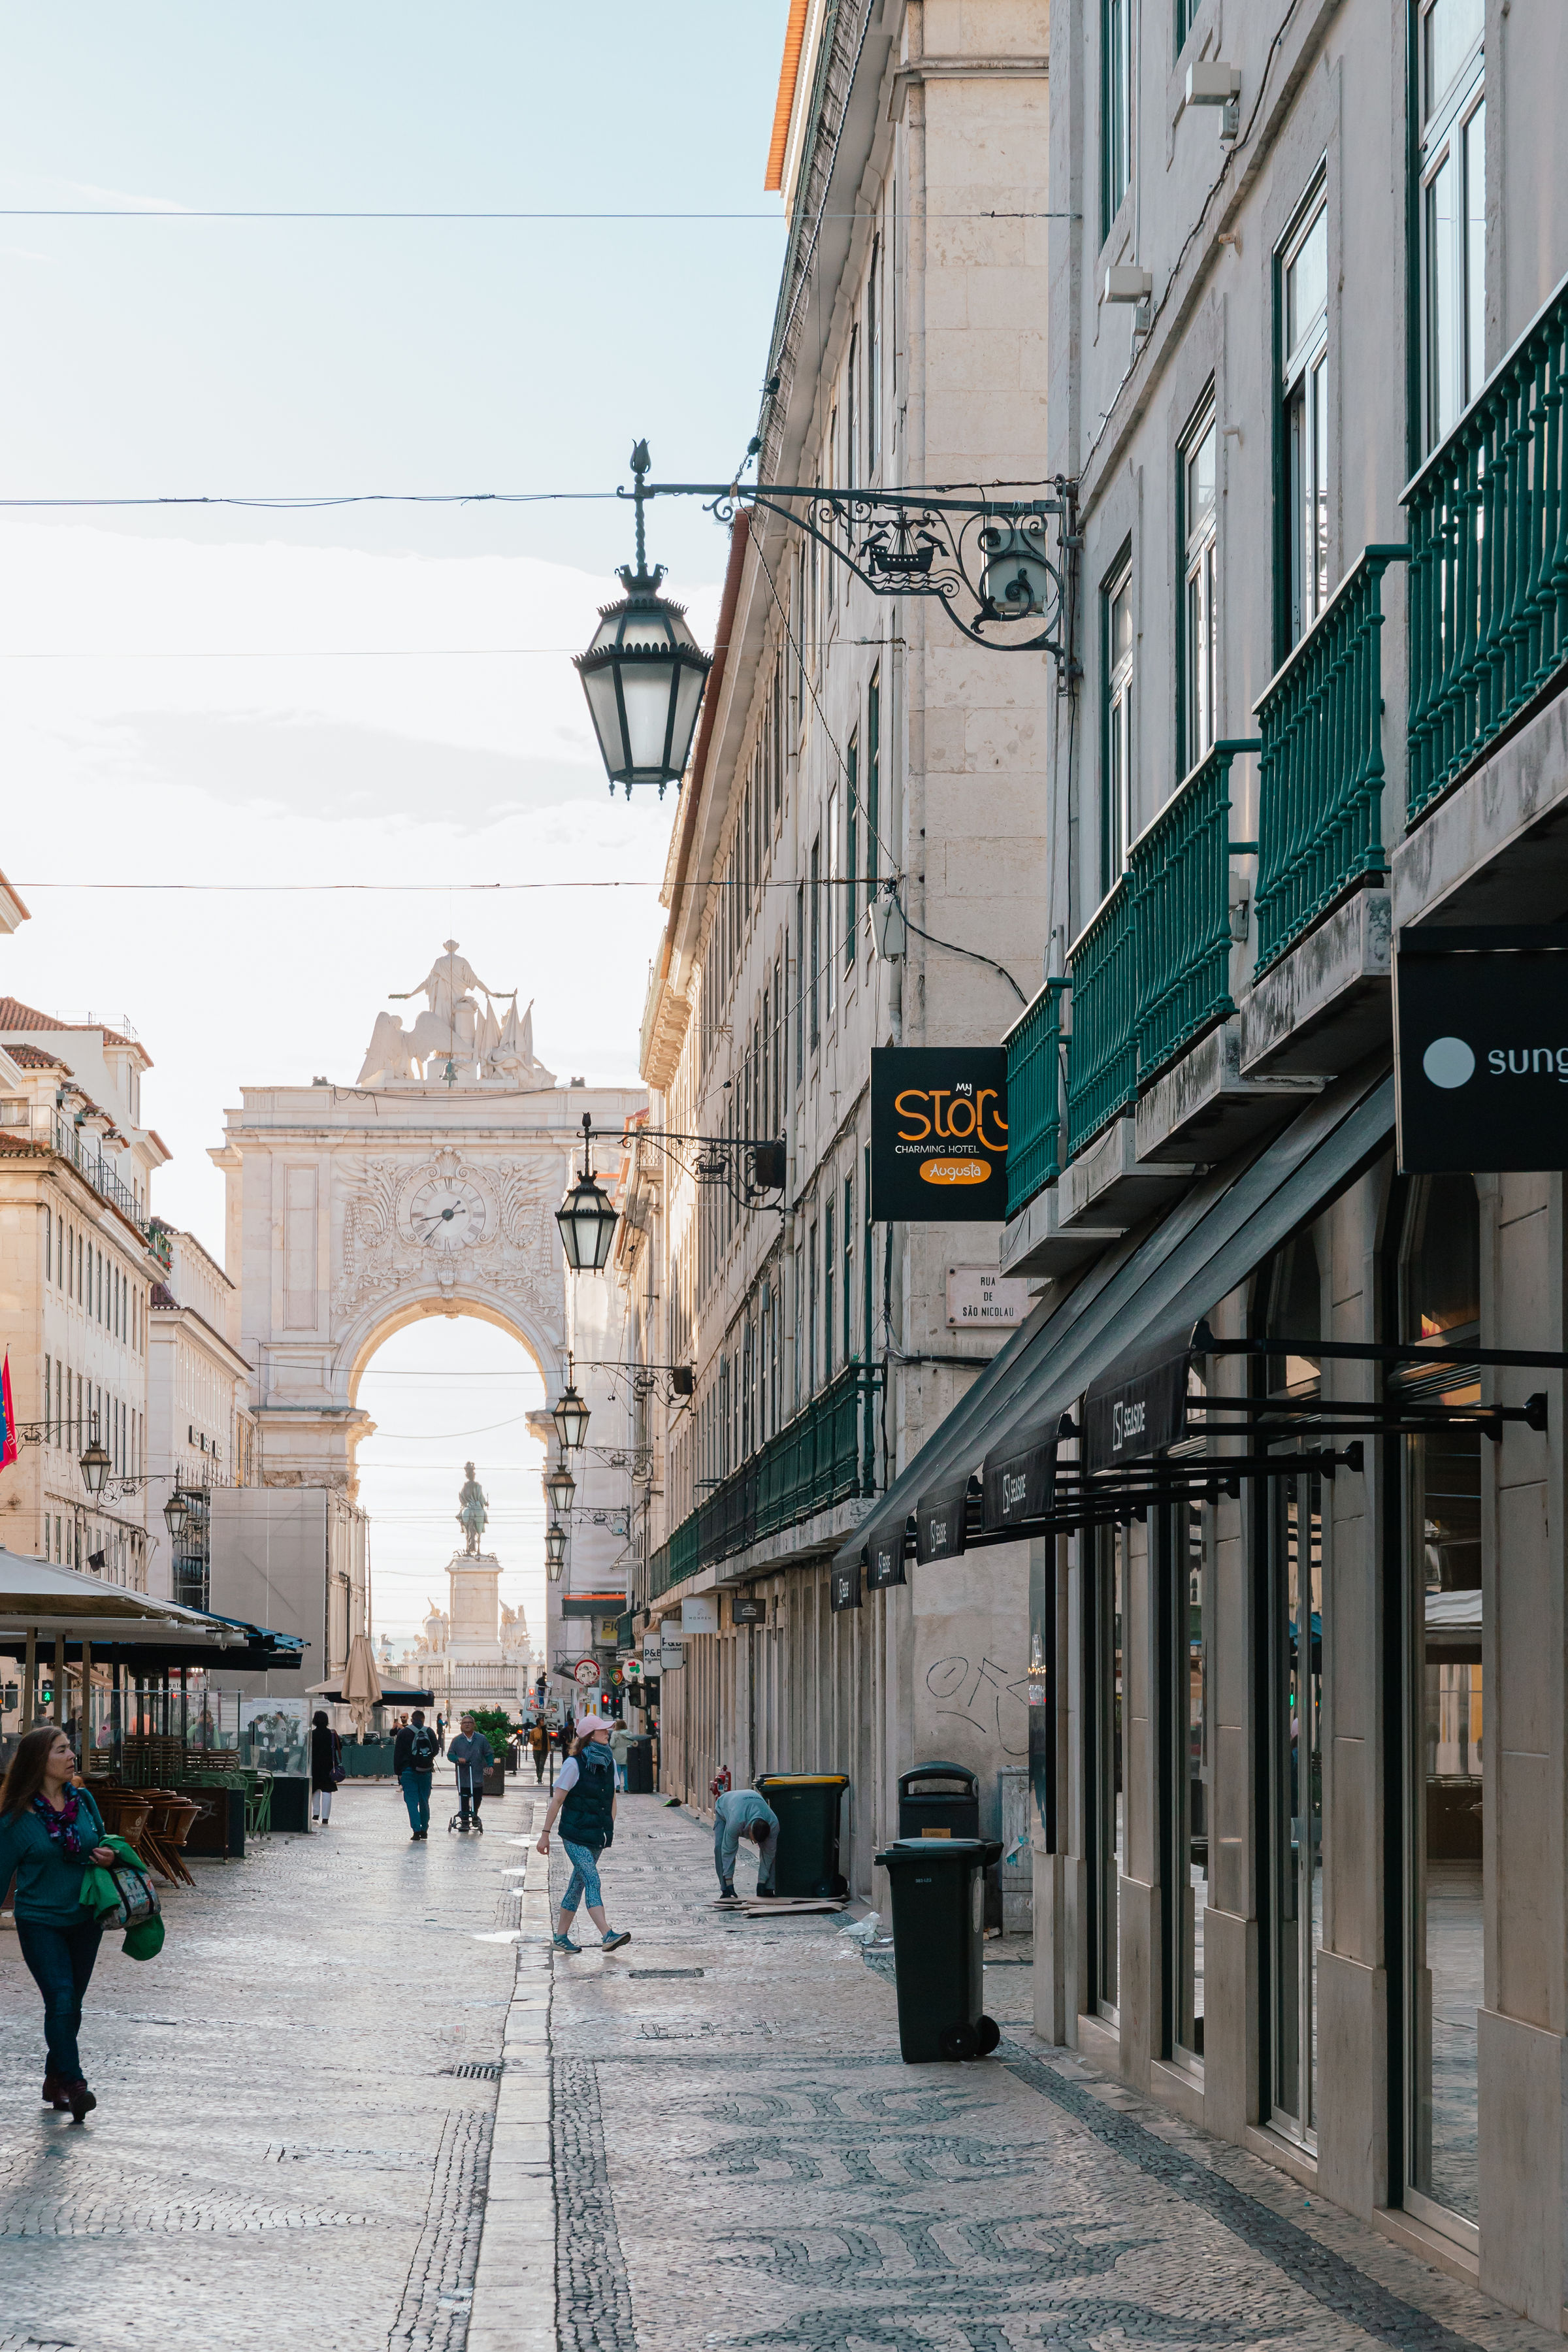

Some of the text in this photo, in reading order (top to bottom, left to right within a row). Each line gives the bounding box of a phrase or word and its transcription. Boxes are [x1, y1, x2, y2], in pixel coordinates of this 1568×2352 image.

[895, 1145, 945, 1154] CHARMING
[930, 1162, 981, 1181] Augusta
[981, 1277, 996, 1286] RUA
[983, 1292, 992, 1301] DE
[962, 1305, 1014, 1316] SÃO NICOLAU
[1124, 1401, 1145, 1437] SEASIDE
